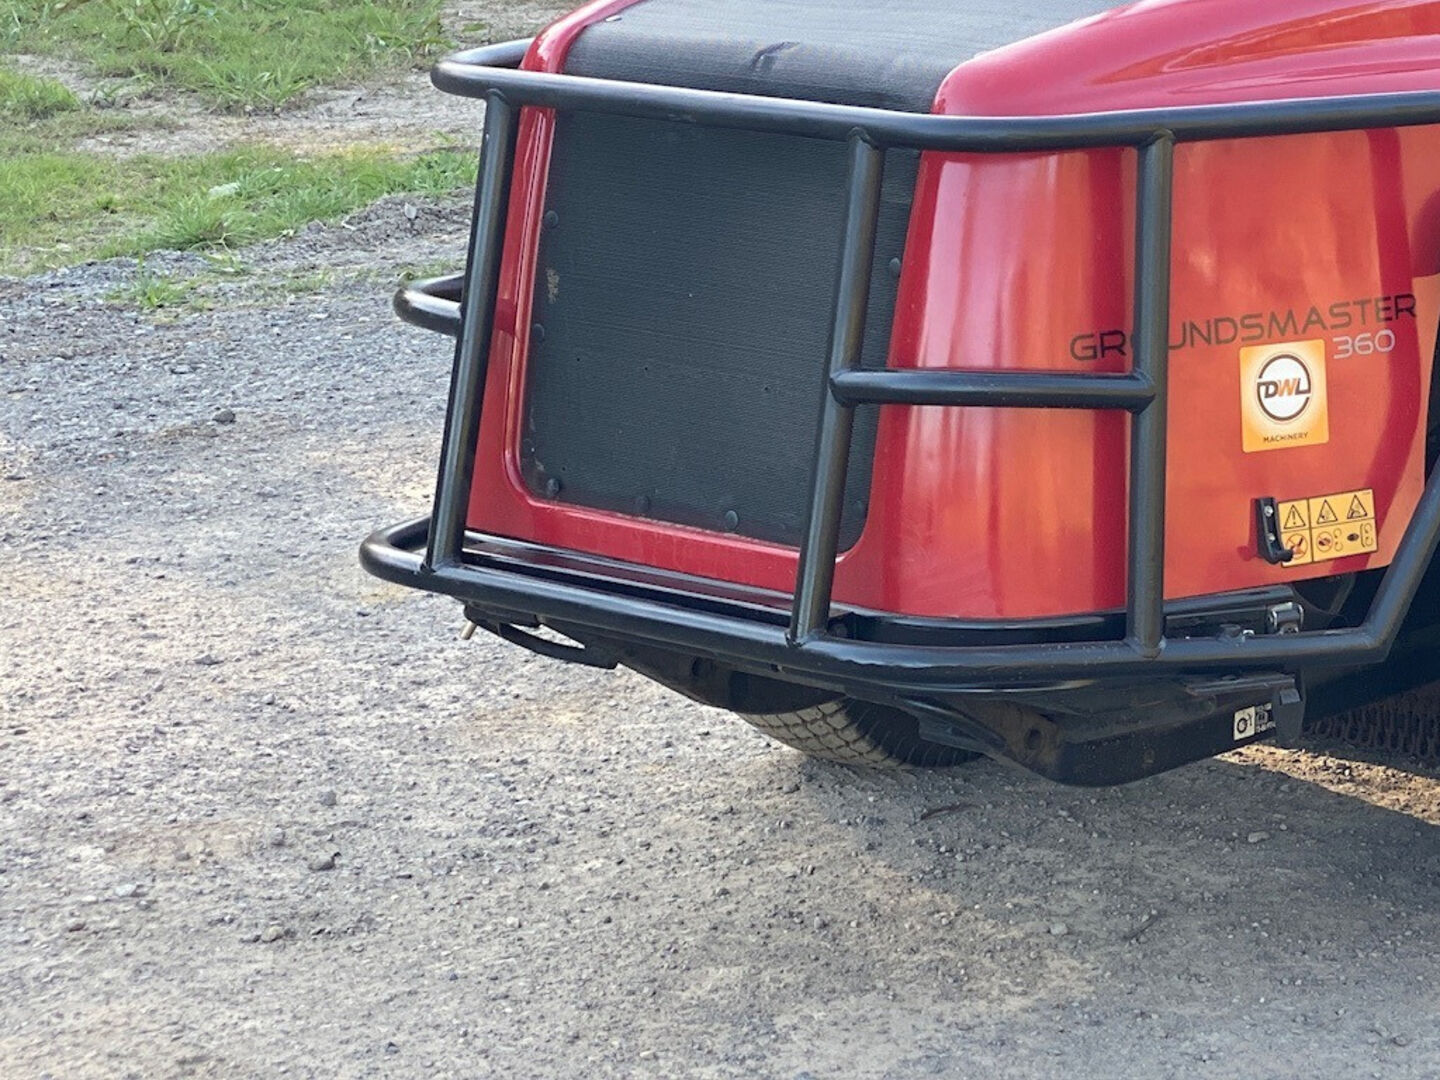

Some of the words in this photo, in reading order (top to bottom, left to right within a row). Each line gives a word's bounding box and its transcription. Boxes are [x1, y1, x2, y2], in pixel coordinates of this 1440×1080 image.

[1069, 293, 1417, 361] GRUNDSMASTER
[1332, 329, 1396, 360] 360
[1258, 377, 1311, 399] DWL
[1263, 431, 1309, 443] MACHINERY
